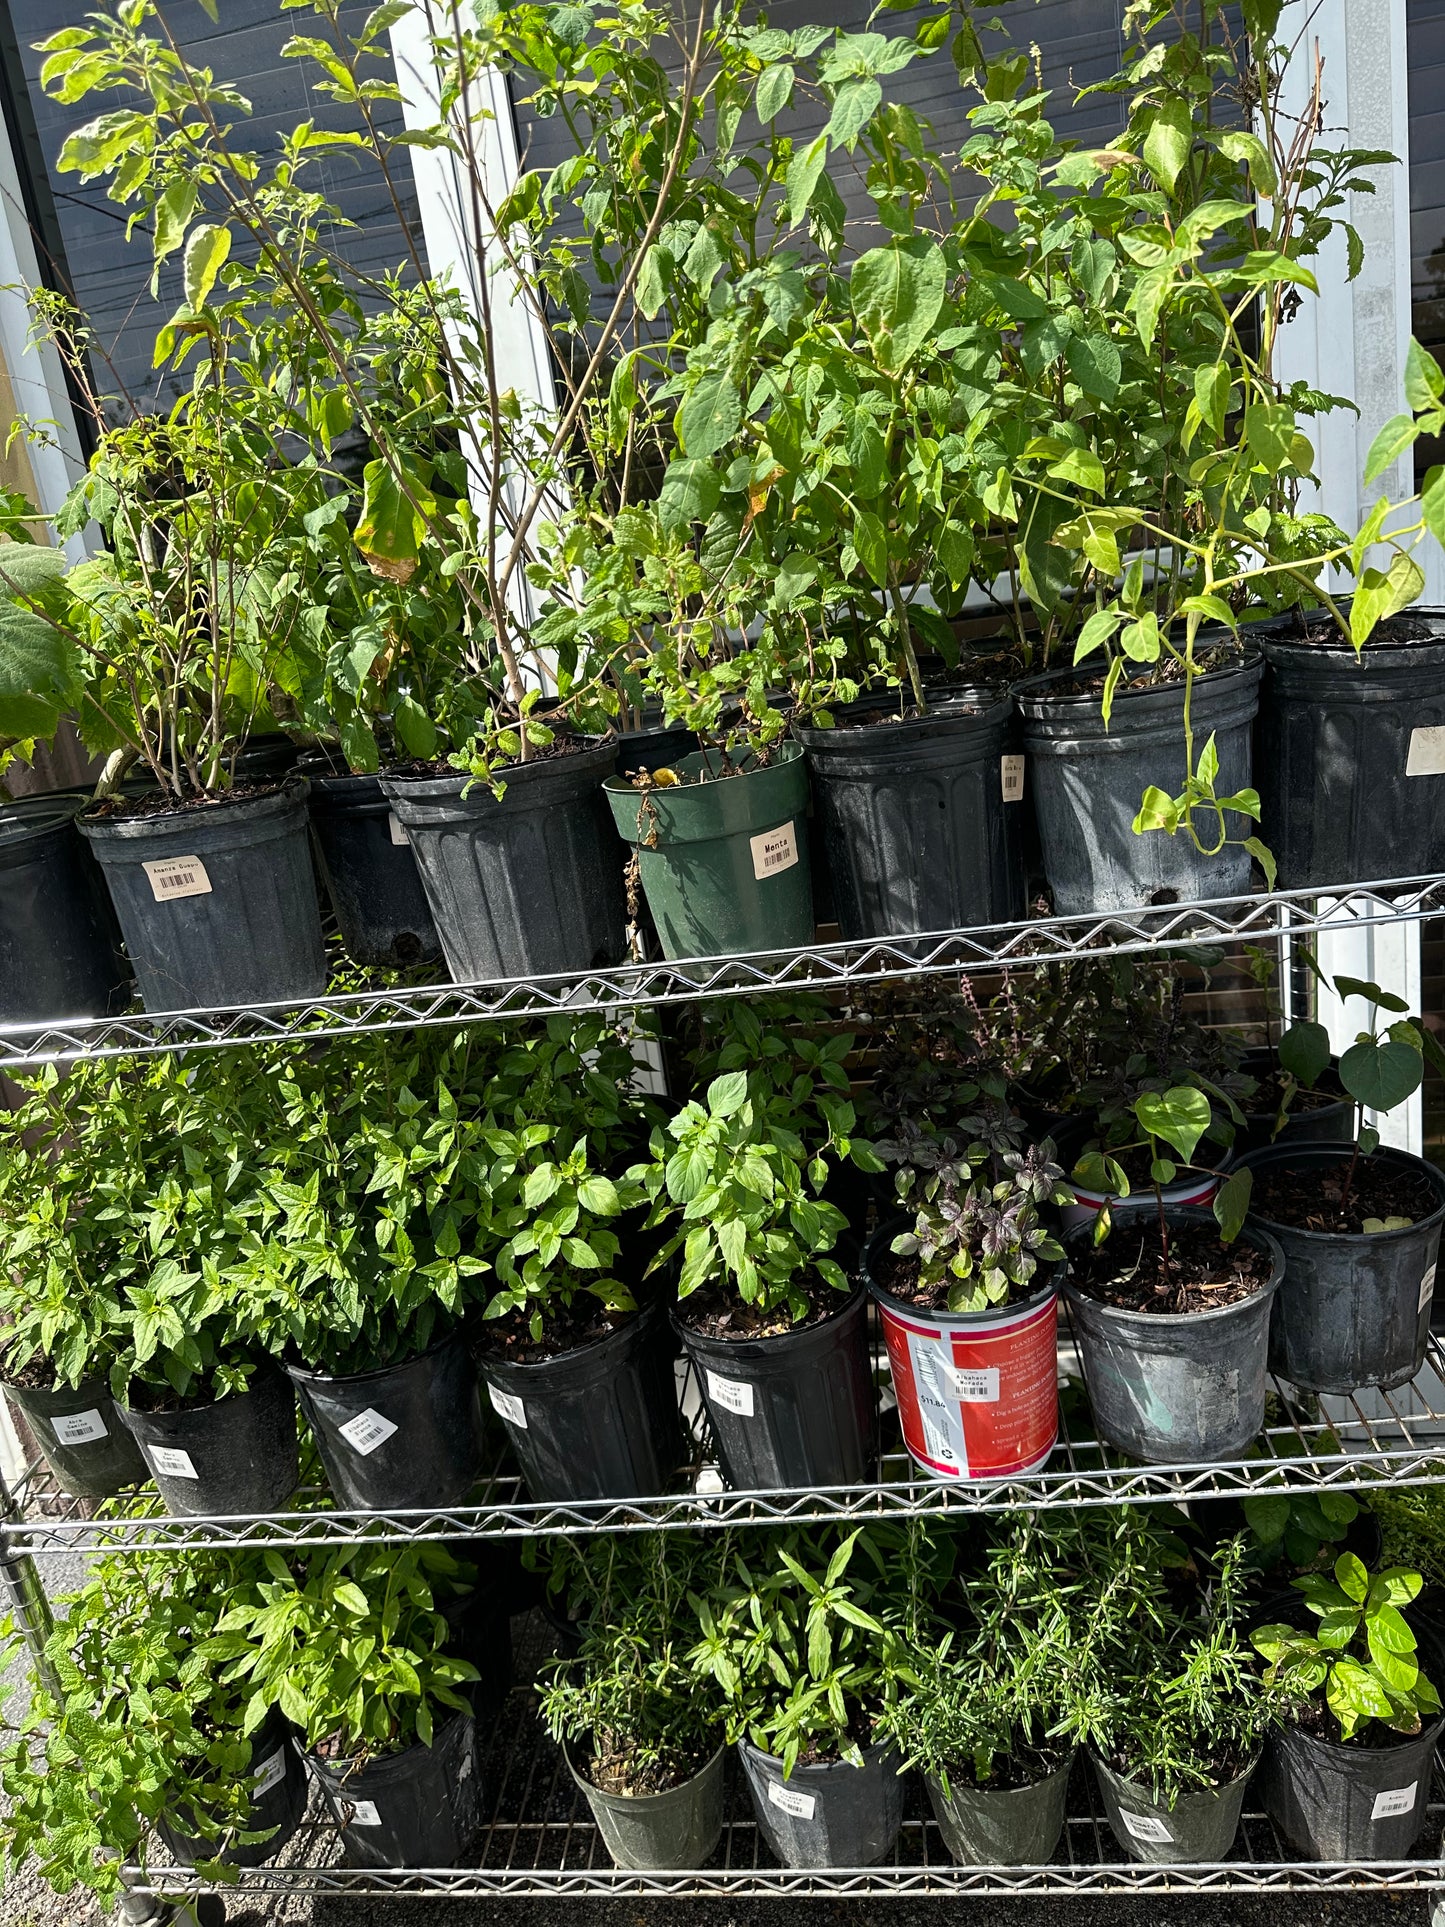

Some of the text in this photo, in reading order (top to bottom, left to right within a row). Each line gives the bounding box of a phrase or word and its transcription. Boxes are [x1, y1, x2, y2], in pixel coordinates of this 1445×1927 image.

[764, 839, 788, 853] Menta
[1010, 1333, 1040, 1350] PLANTING
[920, 1394, 946, 1409] $11.84
